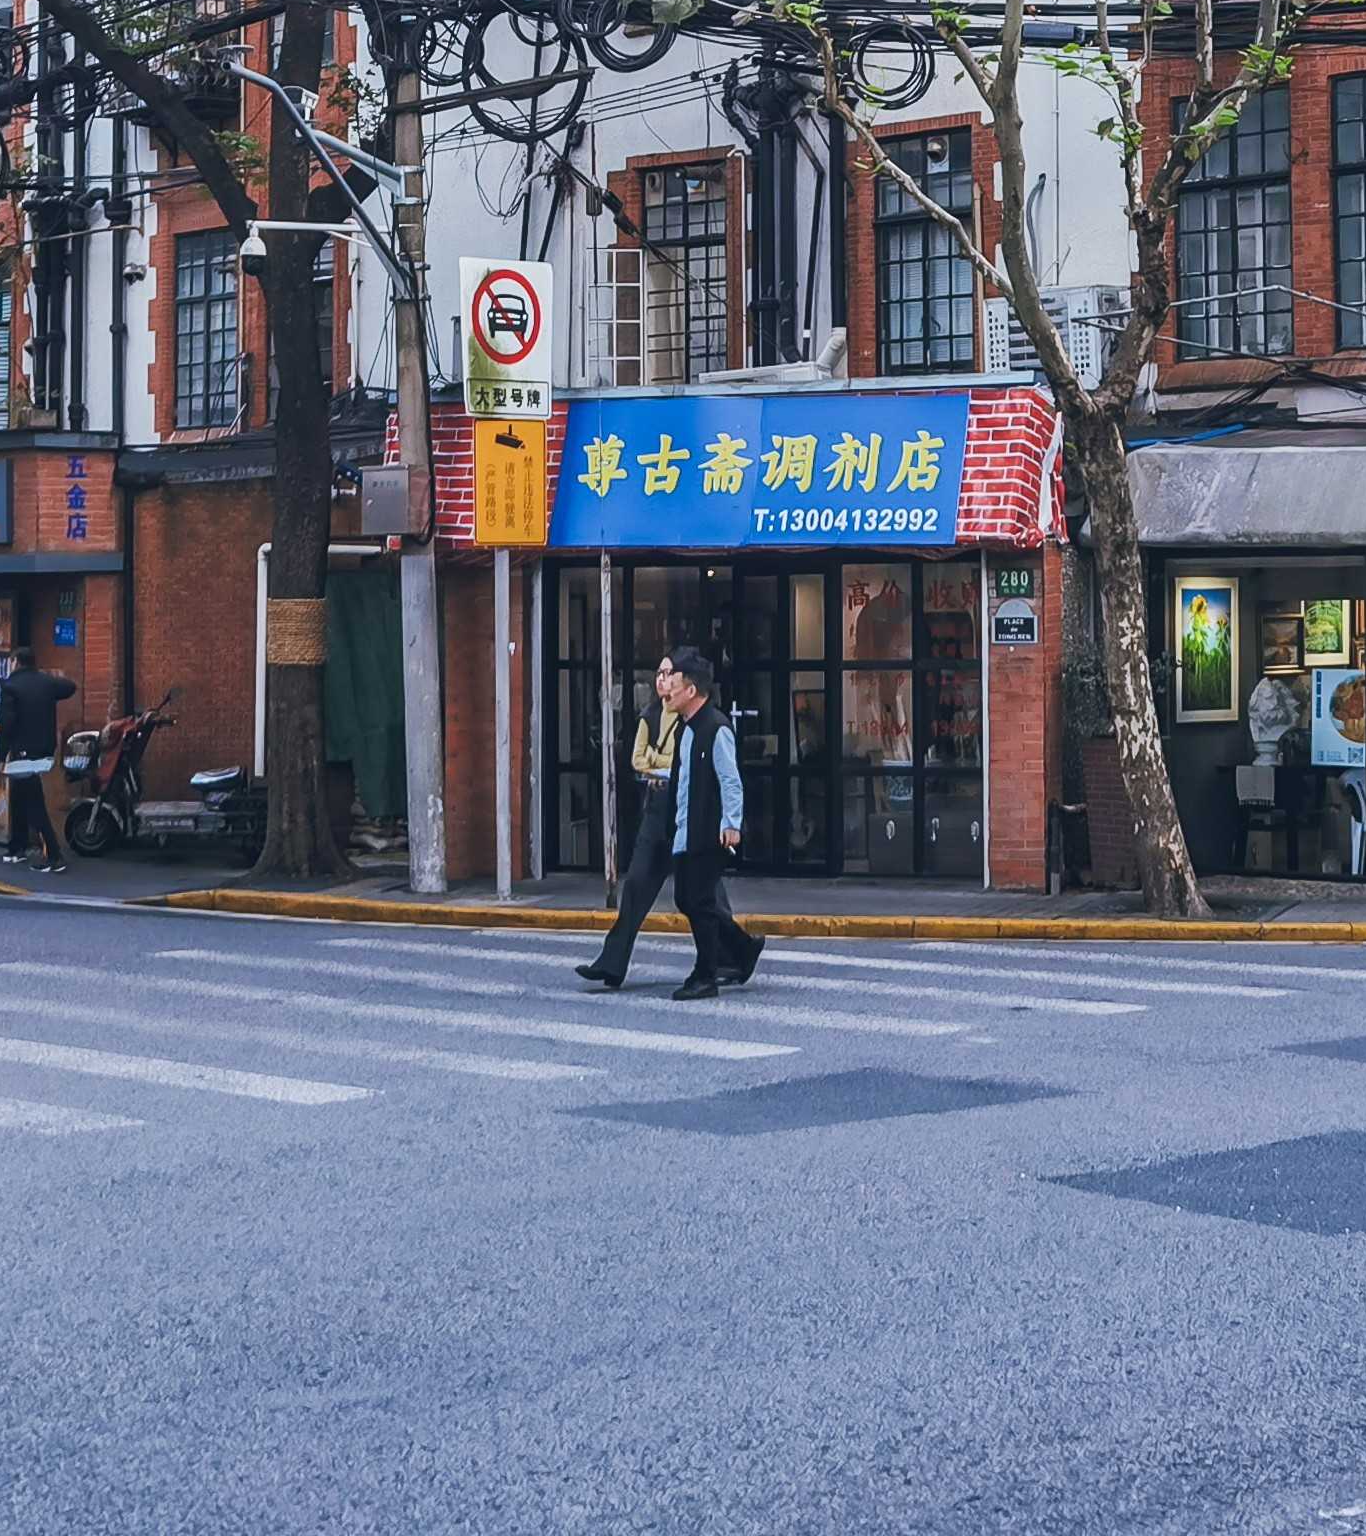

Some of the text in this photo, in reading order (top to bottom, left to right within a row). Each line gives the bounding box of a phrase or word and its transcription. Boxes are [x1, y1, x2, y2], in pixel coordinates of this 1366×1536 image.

[475, 387, 542, 408] 大型号牌
[578, 430, 945, 498] 尊古斋调剂店
[66, 455, 88, 540] 五金店
[754, 508, 939, 533] T:13004132992
[1001, 570, 1029, 587] 280
